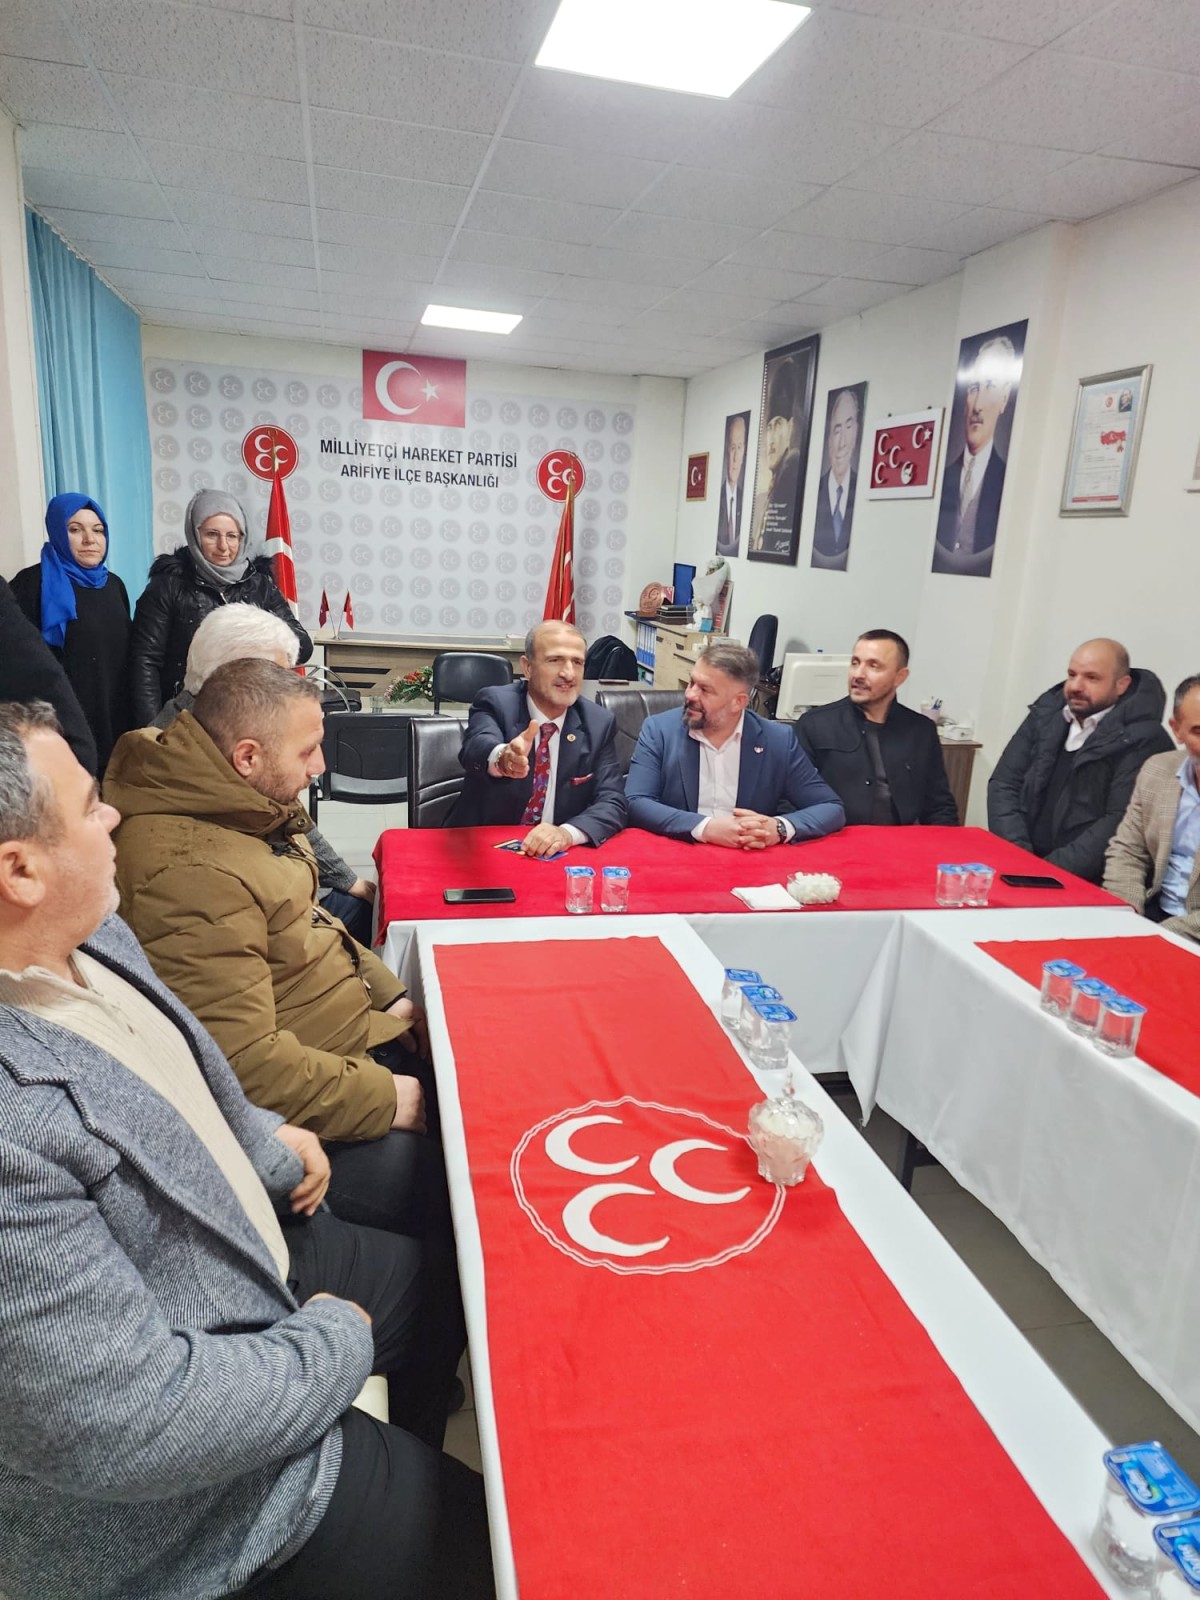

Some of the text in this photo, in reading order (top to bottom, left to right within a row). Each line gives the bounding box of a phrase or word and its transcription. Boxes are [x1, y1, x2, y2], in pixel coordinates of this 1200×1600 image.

[320, 437, 517, 468] MİLLİYETÇİ HAREKET PARTİSİ
[341, 464, 499, 489] ARİFİYE İLÇE BAŞKANLIĞI
